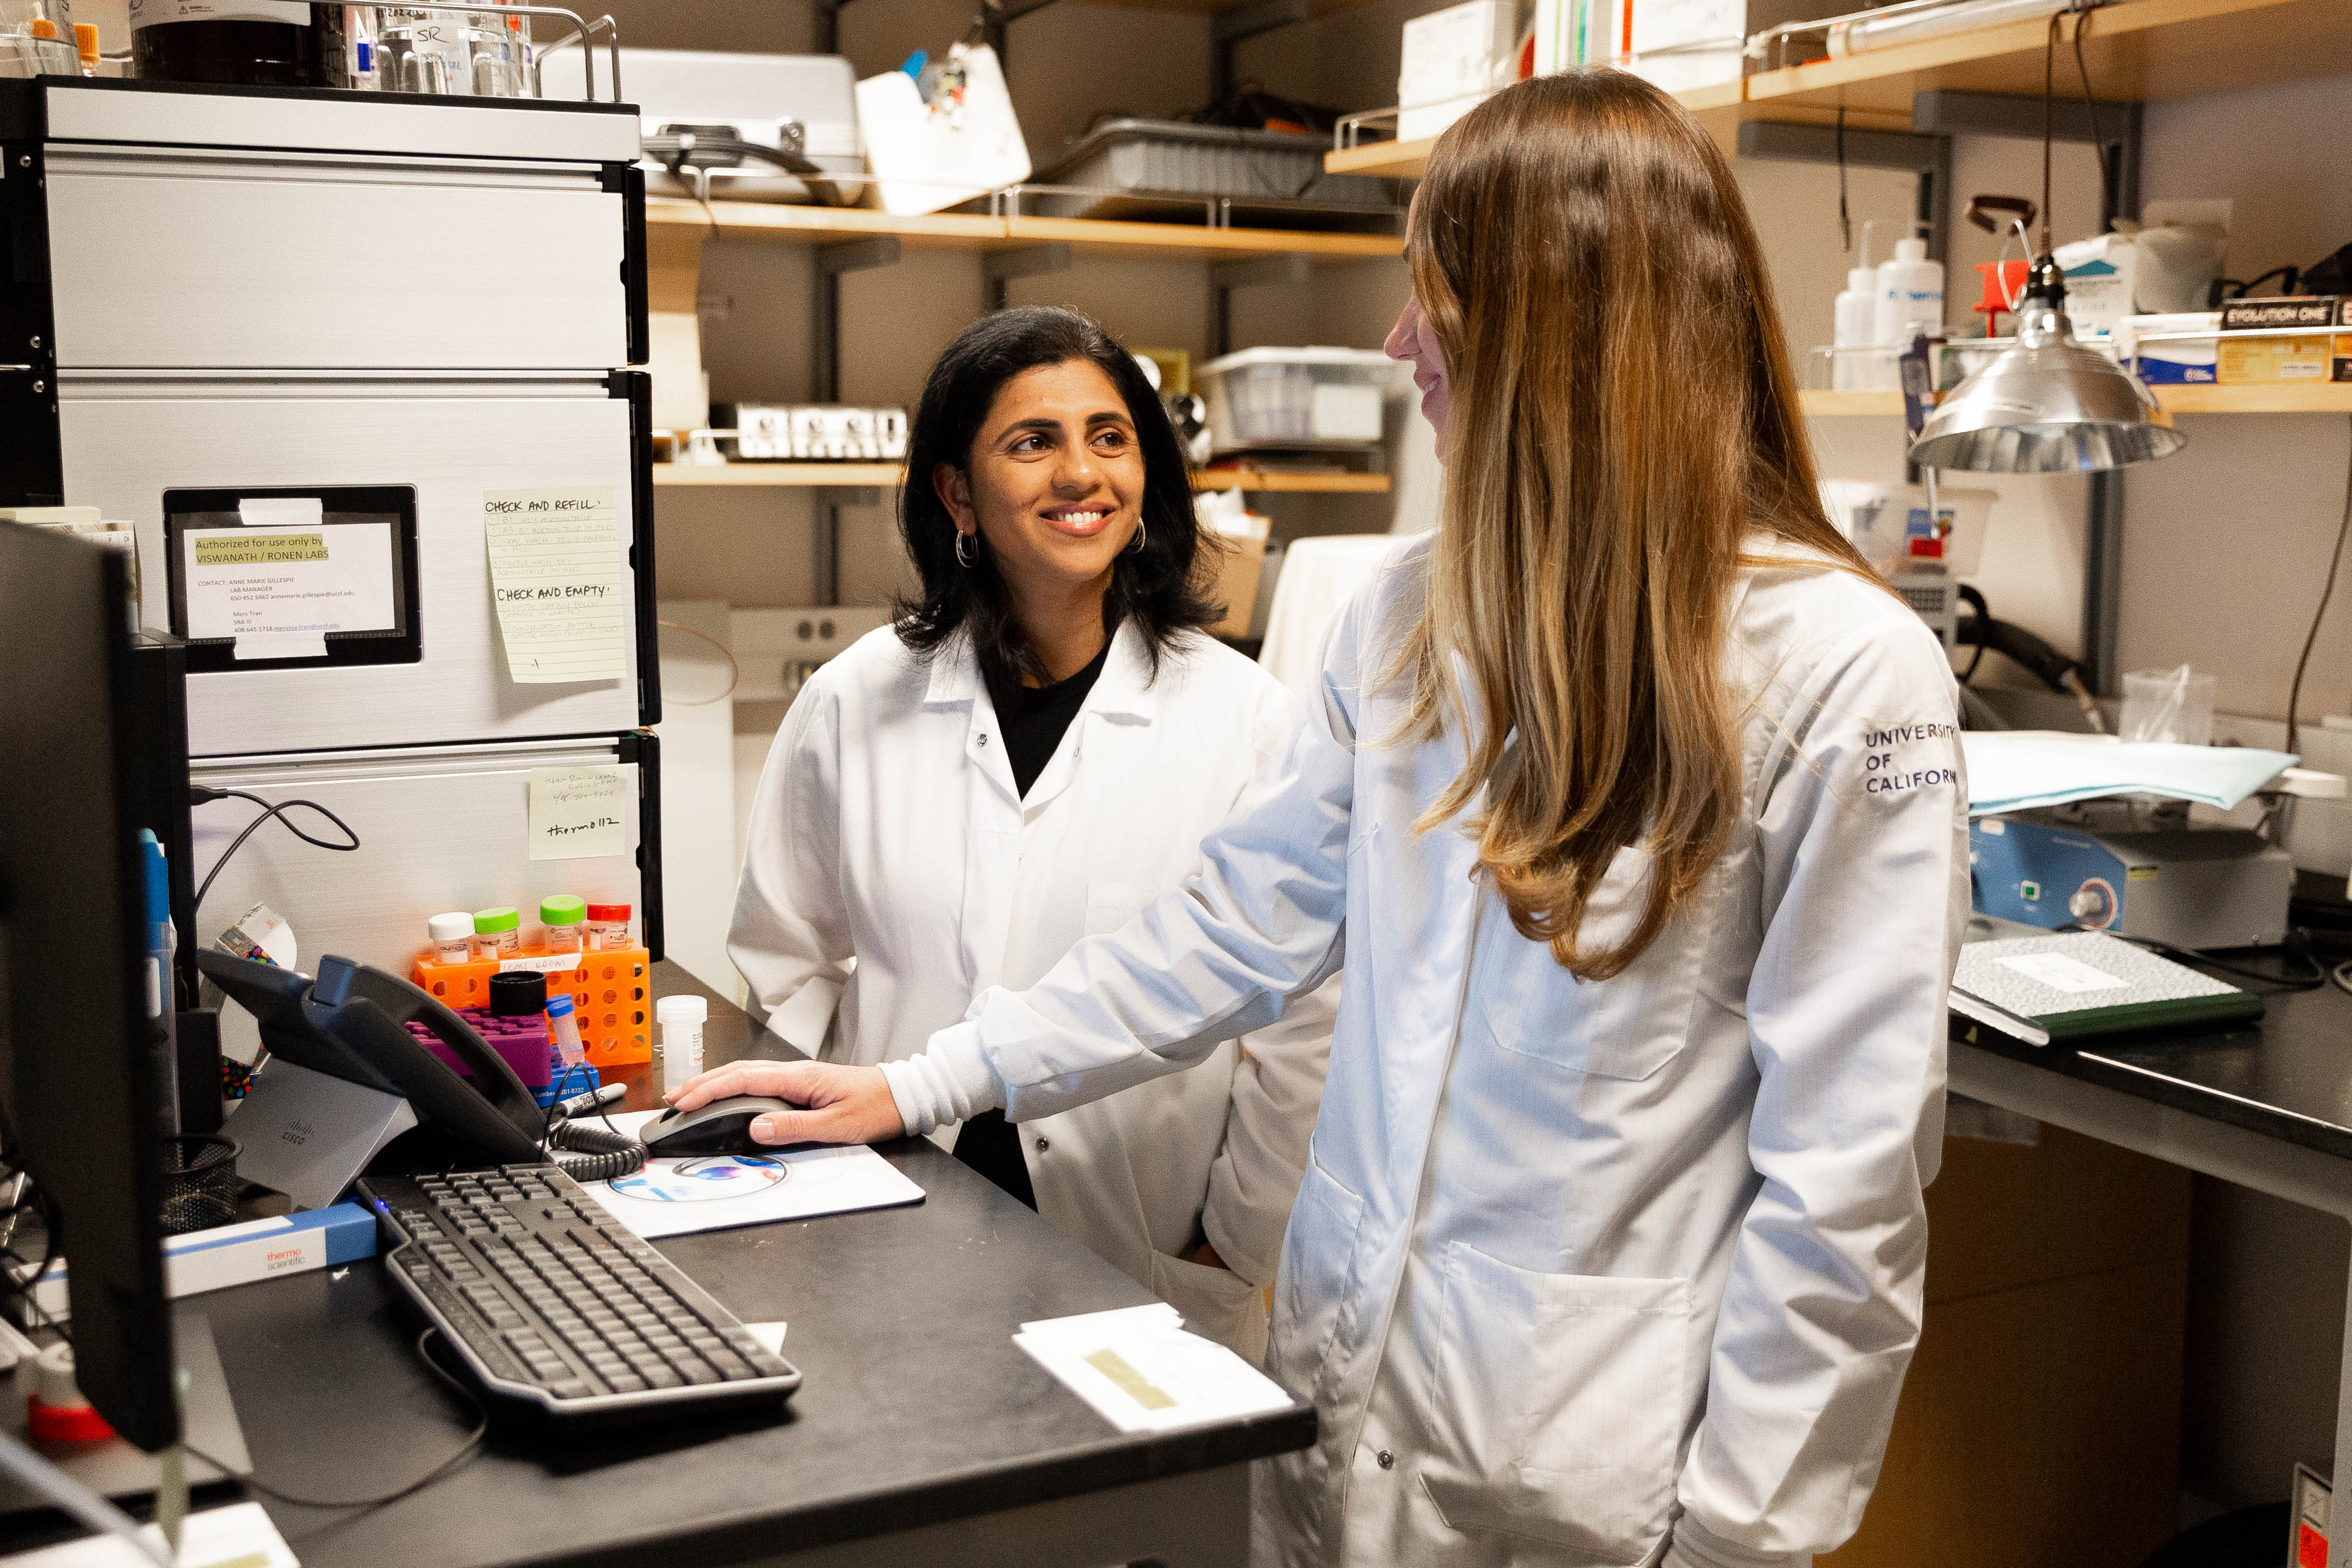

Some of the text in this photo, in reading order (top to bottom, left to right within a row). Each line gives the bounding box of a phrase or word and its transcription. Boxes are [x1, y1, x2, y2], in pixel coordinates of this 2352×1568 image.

[417, 27, 449, 43] SR
[2227, 308, 2296, 322] EVOLUTION
[2298, 307, 2327, 320] ONE
[485, 501, 523, 513] CHECK
[529, 501, 549, 511] AND
[196, 538, 249, 549] Authorized
[253, 538, 267, 547] for
[288, 536, 308, 547] only
[312, 536, 323, 547] by
[197, 550, 329, 563] VISWANATH / RONEN LABS
[270, 591, 355, 599] annemarie.gillespie@ucsf.edu
[497, 589, 534, 601] CHECK
[538, 587, 561, 599] AND
[1866, 724, 1954, 747] UNIVERSITY
[1866, 753, 1891, 770] OF
[536, 960, 565, 968] ROOM
[282, 1132, 304, 1145] cisco
[267, 1249, 302, 1261] thermo
[267, 1256, 305, 1271] scientific
